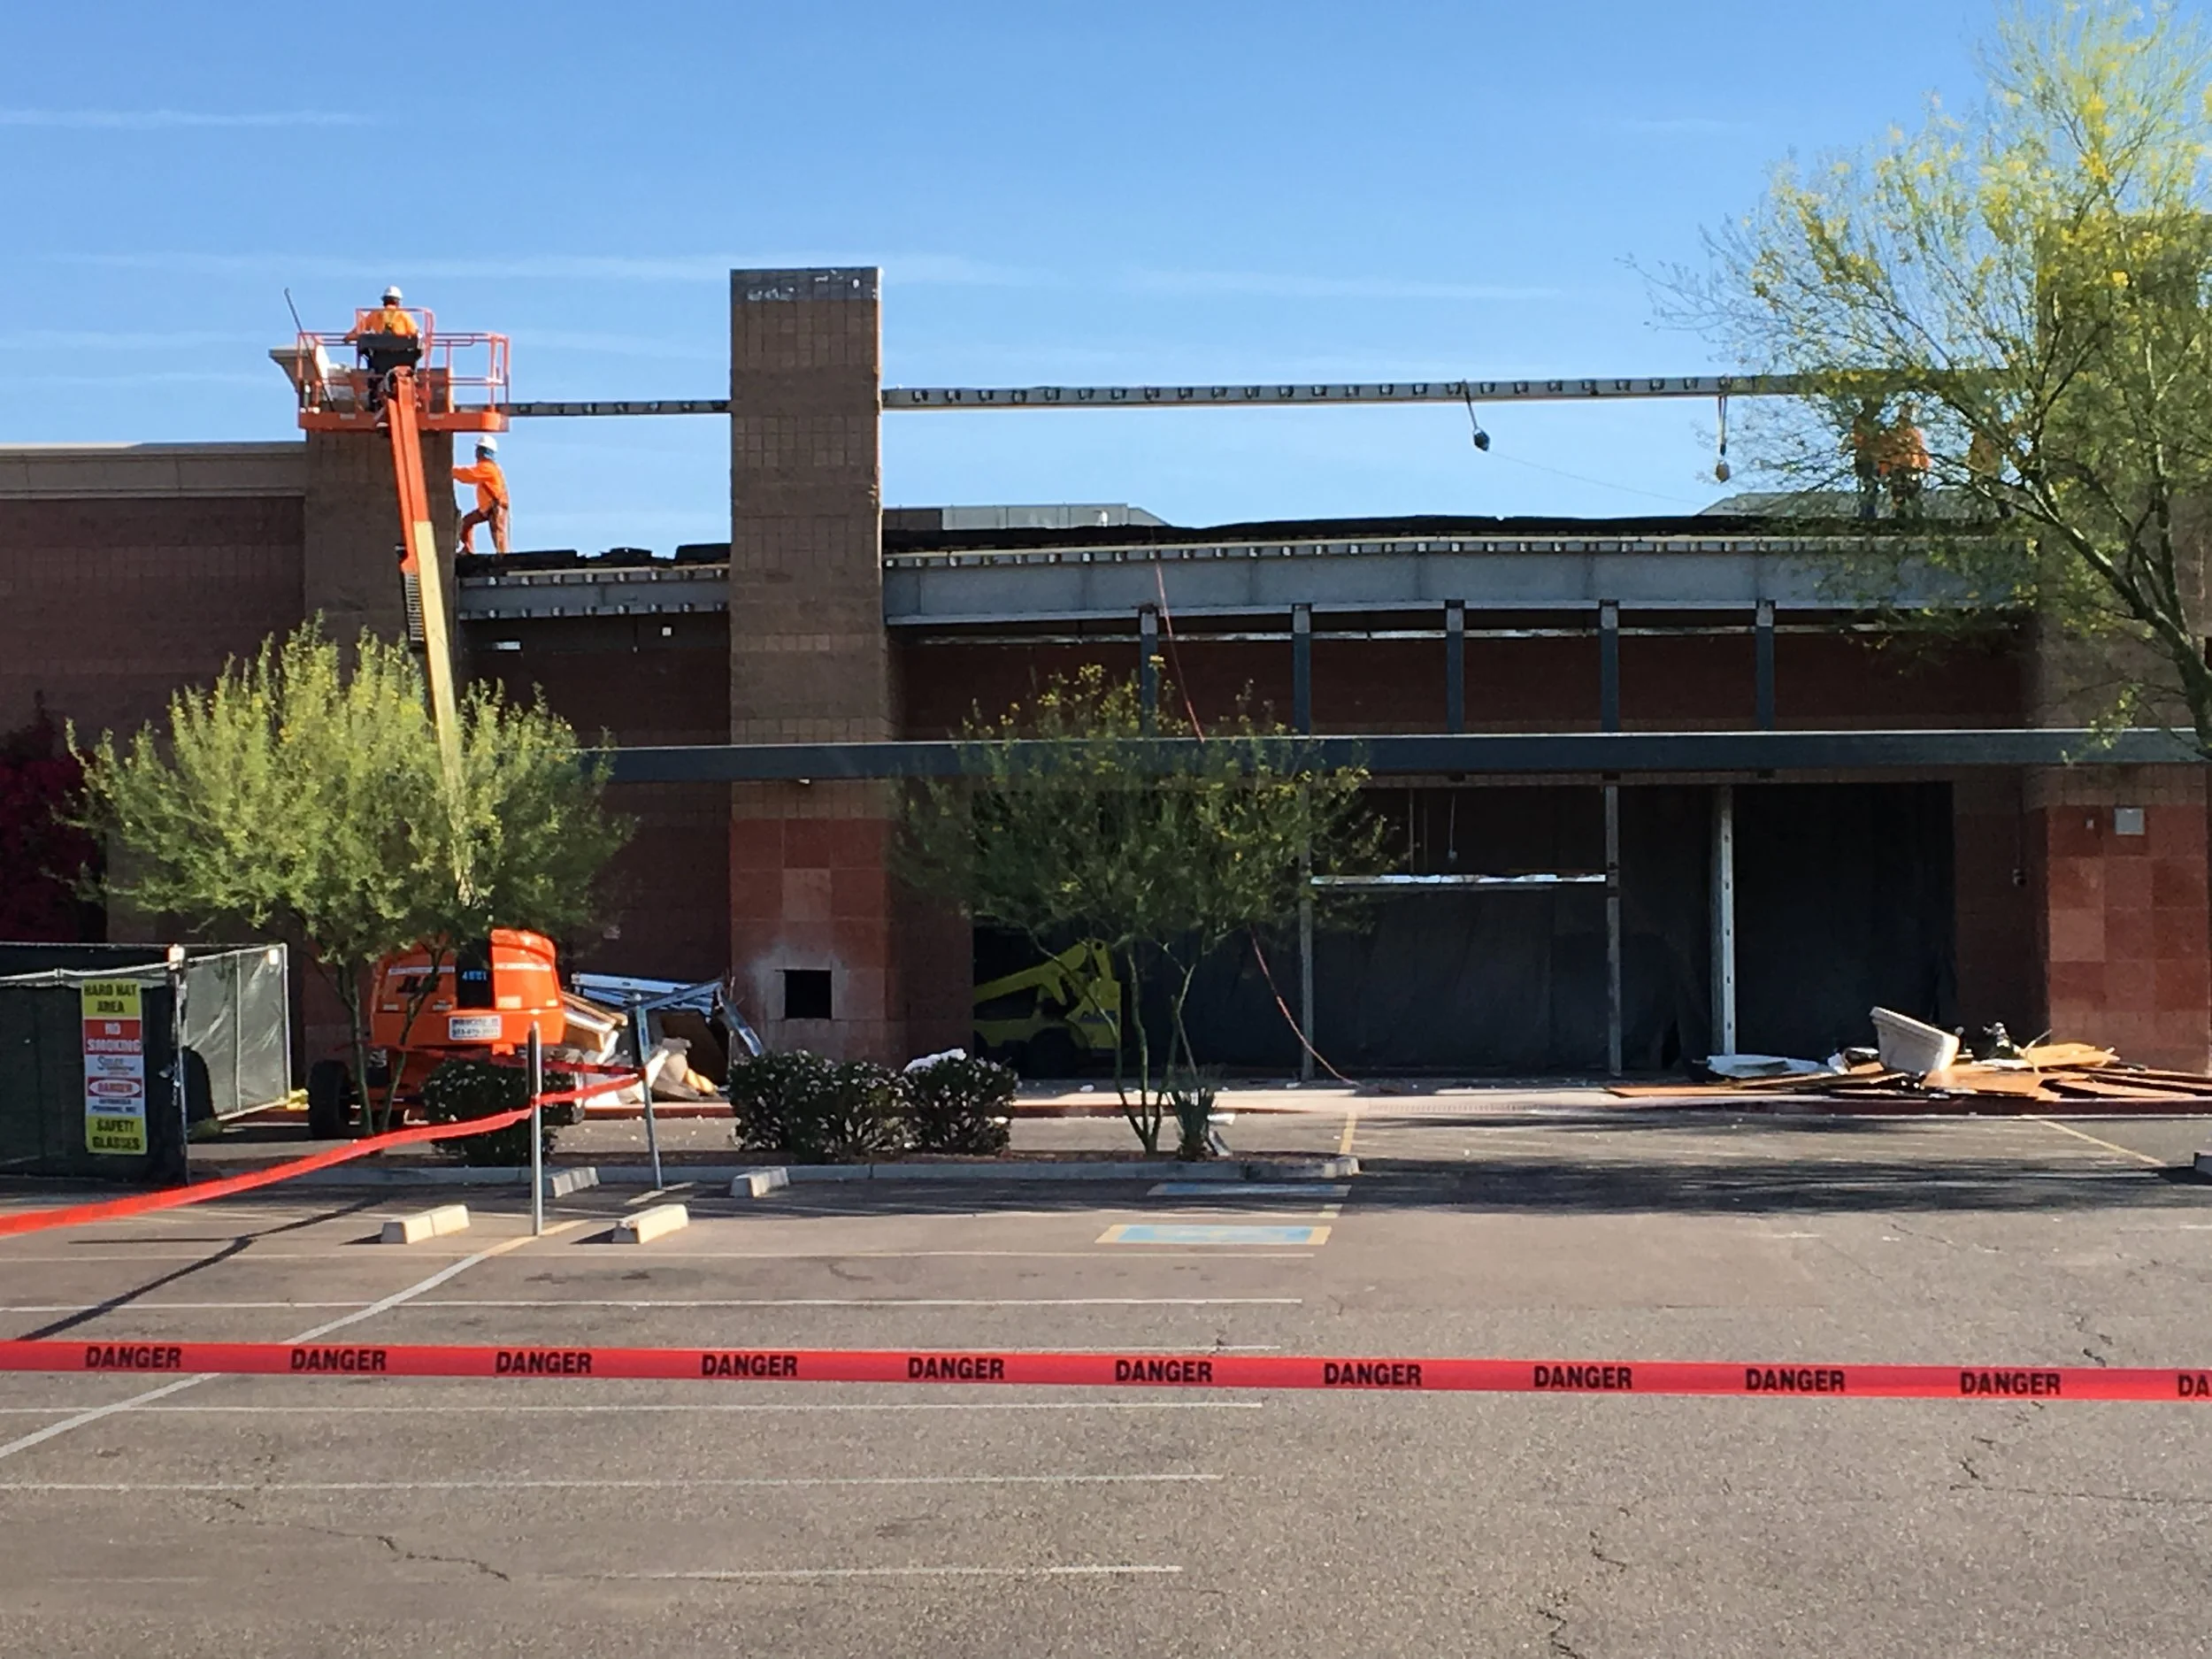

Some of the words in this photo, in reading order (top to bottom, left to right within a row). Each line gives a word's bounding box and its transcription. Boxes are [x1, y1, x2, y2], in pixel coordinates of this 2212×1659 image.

[83, 984, 113, 996] HARD
[116, 984, 137, 996] HAT
[96, 1001, 125, 1013] AREA
[87, 1039, 142, 1053] SMOKING
[96, 1118, 135, 1133] SAFETY
[92, 1136, 141, 1150] GLASSES
[86, 1345, 181, 1368] DANGER
[290, 1348, 386, 1371] DANGER
[495, 1350, 592, 1375] DANGER
[702, 1353, 797, 1378] DANGER
[909, 1356, 1003, 1380] DANGER
[1116, 1358, 1211, 1384] DANGER
[1325, 1361, 1421, 1386] DANGER
[1534, 1363, 1632, 1389] DANGER
[1746, 1367, 1845, 1392] DANGER
[1960, 1371, 2061, 1395] DANGER
[2178, 1374, 2208, 1397] DA
